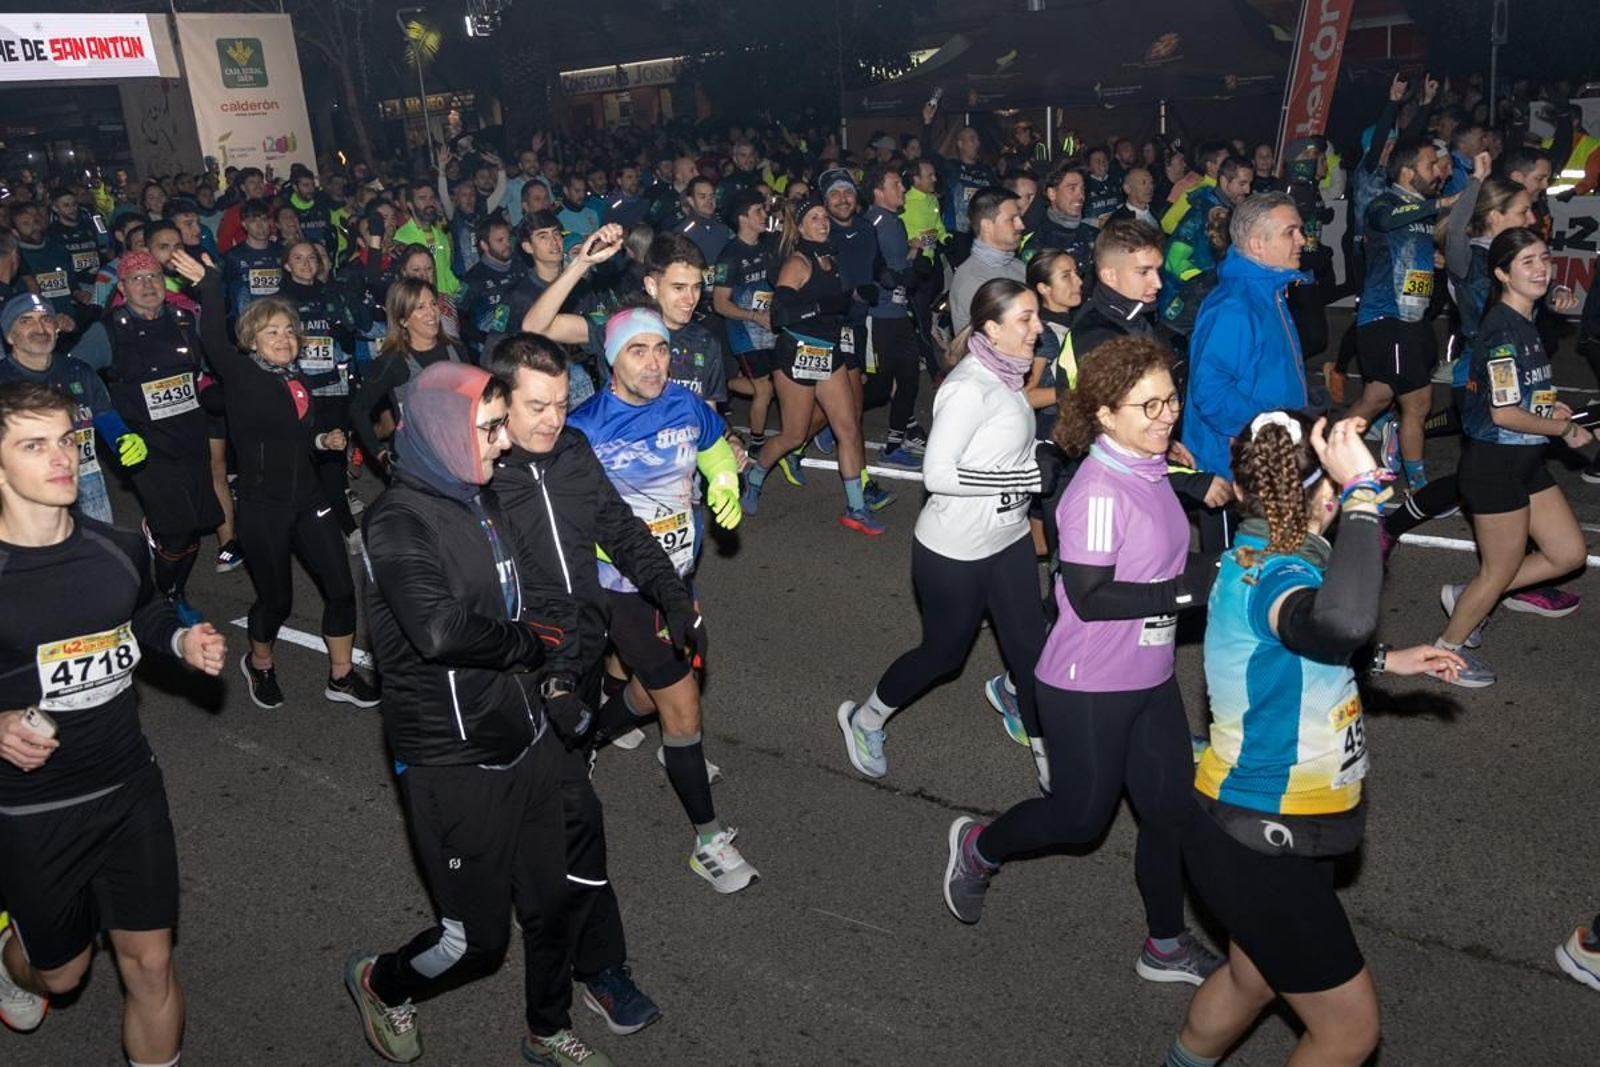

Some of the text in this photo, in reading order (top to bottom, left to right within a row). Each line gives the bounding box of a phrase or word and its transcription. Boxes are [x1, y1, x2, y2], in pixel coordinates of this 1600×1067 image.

[20, 38, 48, 61] DE
[49, 37, 86, 60] SAN
[220, 100, 279, 112] calderón
[797, 354, 829, 369] 9733
[151, 383, 191, 406] 5430
[51, 645, 133, 685] 4718
